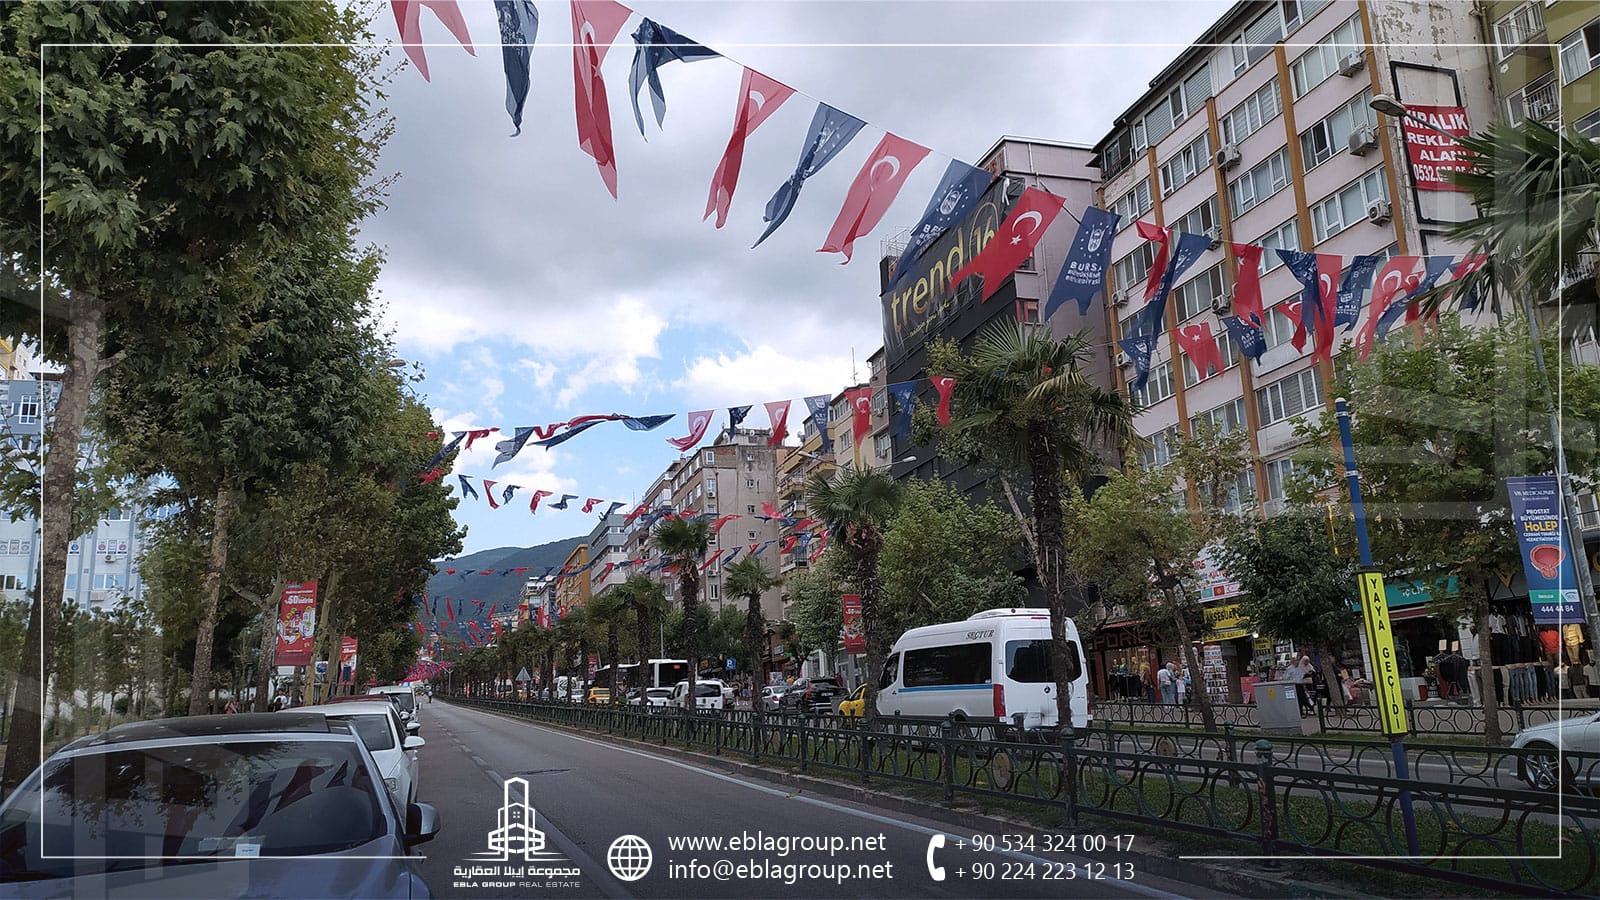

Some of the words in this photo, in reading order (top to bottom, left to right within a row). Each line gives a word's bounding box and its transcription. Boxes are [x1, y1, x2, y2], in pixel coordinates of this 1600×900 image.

[1407, 132, 1465, 146] REKLA
[891, 226, 964, 333] trend
[1524, 520, 1558, 531] HoLEP
[1370, 578, 1385, 631] YAYA
[1541, 605, 1554, 613] 444
[1382, 647, 1401, 730] GEÇİDİ
